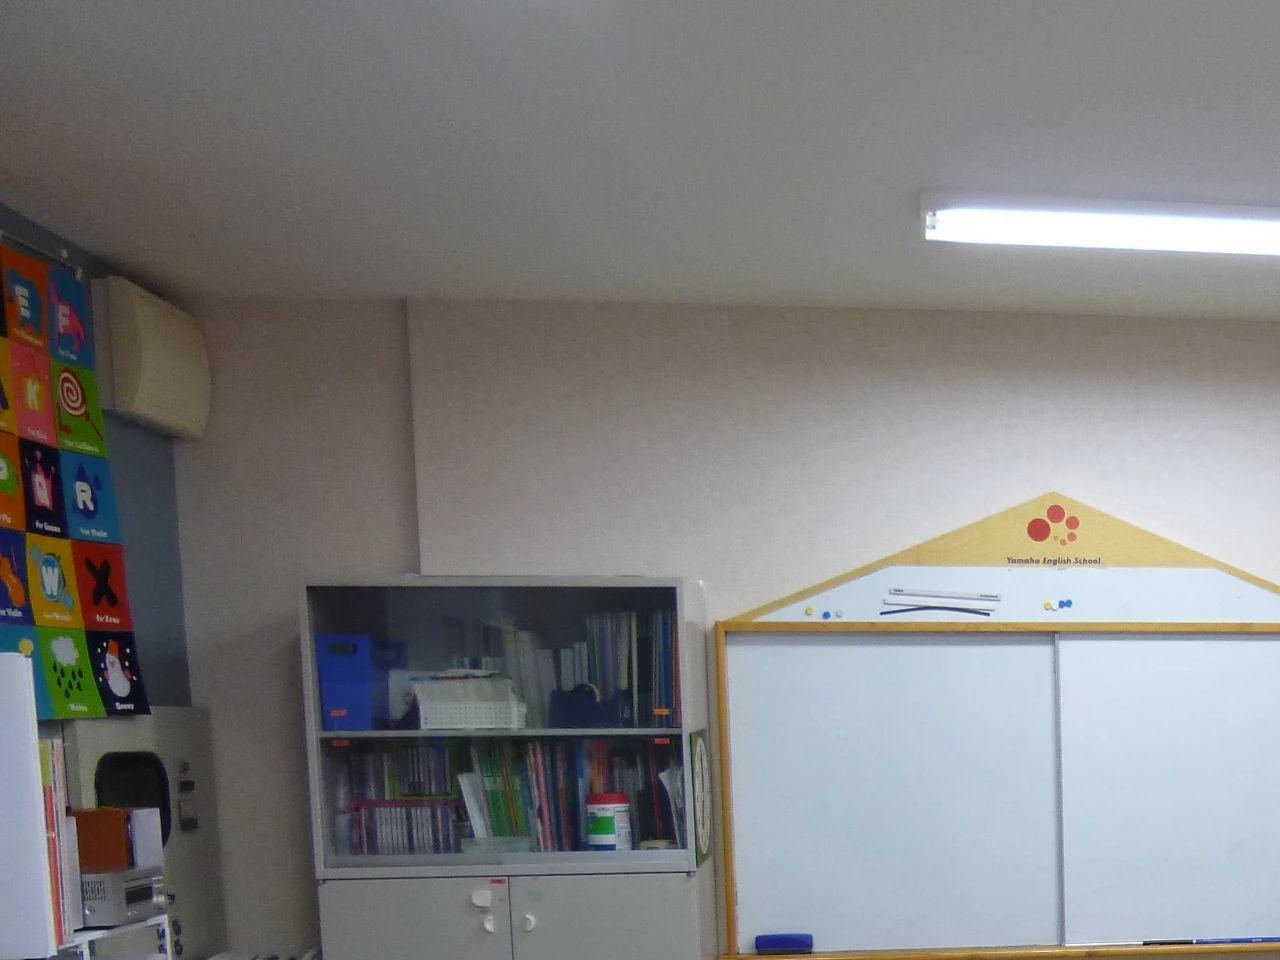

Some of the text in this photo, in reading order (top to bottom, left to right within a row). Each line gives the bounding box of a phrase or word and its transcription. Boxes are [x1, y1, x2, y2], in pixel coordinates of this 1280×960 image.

[25, 377, 40, 411] K
[75, 480, 94, 511] R
[1007, 556, 1101, 566] Yamaha English School
[41, 565, 59, 596] W
[84, 556, 118, 607] X
